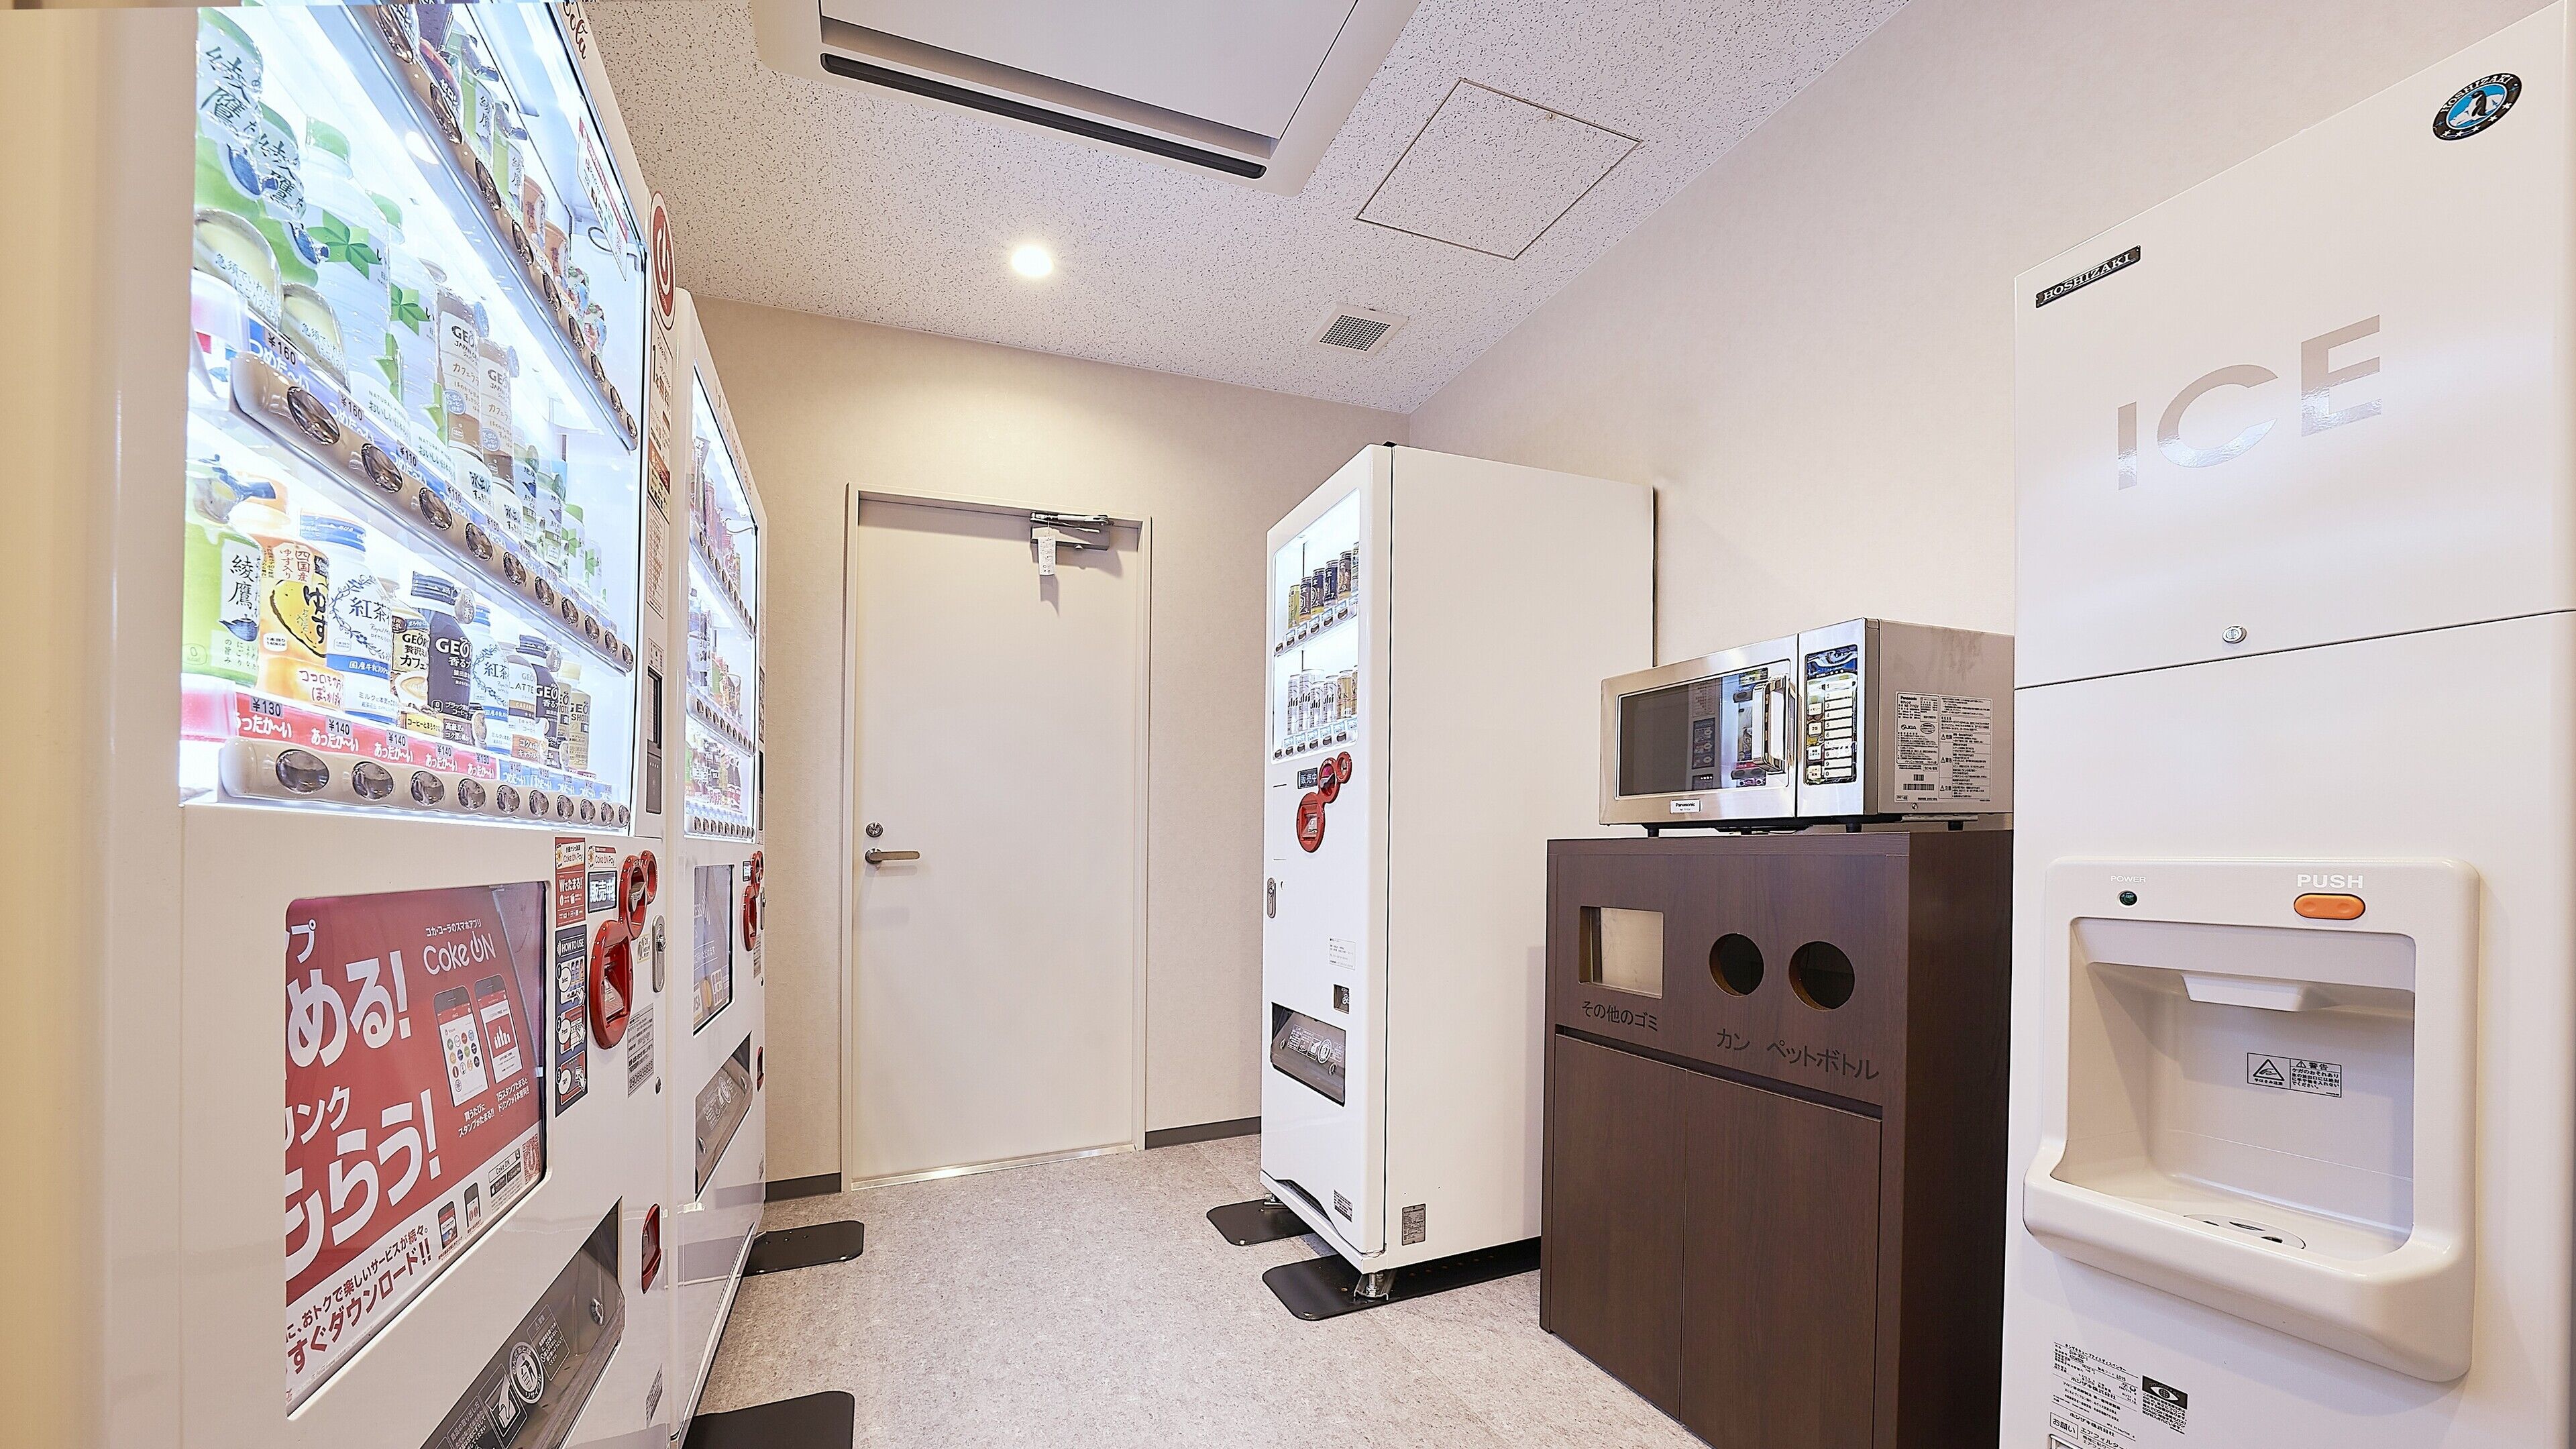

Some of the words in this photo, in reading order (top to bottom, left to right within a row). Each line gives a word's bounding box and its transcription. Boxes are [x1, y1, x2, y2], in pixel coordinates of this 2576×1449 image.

[200, 46, 251, 121] 綾鷹
[2440, 74, 2514, 113] HOSHIZAKI
[2042, 253, 2132, 301] HOSHIZAKI
[268, 333, 296, 365] ¥160
[341, 394, 363, 421] ¥160
[2118, 314, 2381, 490] ICE
[400, 445, 417, 467] ¥110
[279, 549, 293, 580] ゆず入り
[295, 550, 311, 582] 四国産
[229, 554, 254, 610] 綾鷹
[303, 585, 328, 644] ゆず
[349, 596, 390, 623] 紅茶
[436, 637, 472, 658] GEO
[252, 698, 281, 717] ¥130
[328, 719, 350, 735] ¥140
[388, 733, 406, 746] ¥140
[437, 745, 452, 757] ¥140
[1300, 773, 1318, 784] 販売中
[590, 877, 616, 903] 販売中
[2110, 875, 2147, 883] POWER
[2297, 874, 2365, 889] PUSH
[288, 918, 317, 963] プ
[425, 918, 482, 937] コカ・コーラのスマホアプリ
[423, 941, 470, 975] Coke
[470, 930, 496, 963] ON
[287, 950, 412, 1068] める!
[1582, 1001, 1658, 1032] その他のゴミ
[1716, 1028, 1751, 1051] カン
[1767, 1040, 1879, 1080] ペットボトル
[2292, 1067, 2339, 1079] ケガのおそれあり
[2308, 1062, 2328, 1071] 警告
[496, 1076, 529, 1103] 15スタンプたまると
[458, 1108, 495, 1138] スタンプがたまる!!
[464, 1102, 486, 1122] 買うたびに
[2053, 1418, 2076, 1434] お願い
[2080, 1427, 2125, 1449] エアフィルタ
